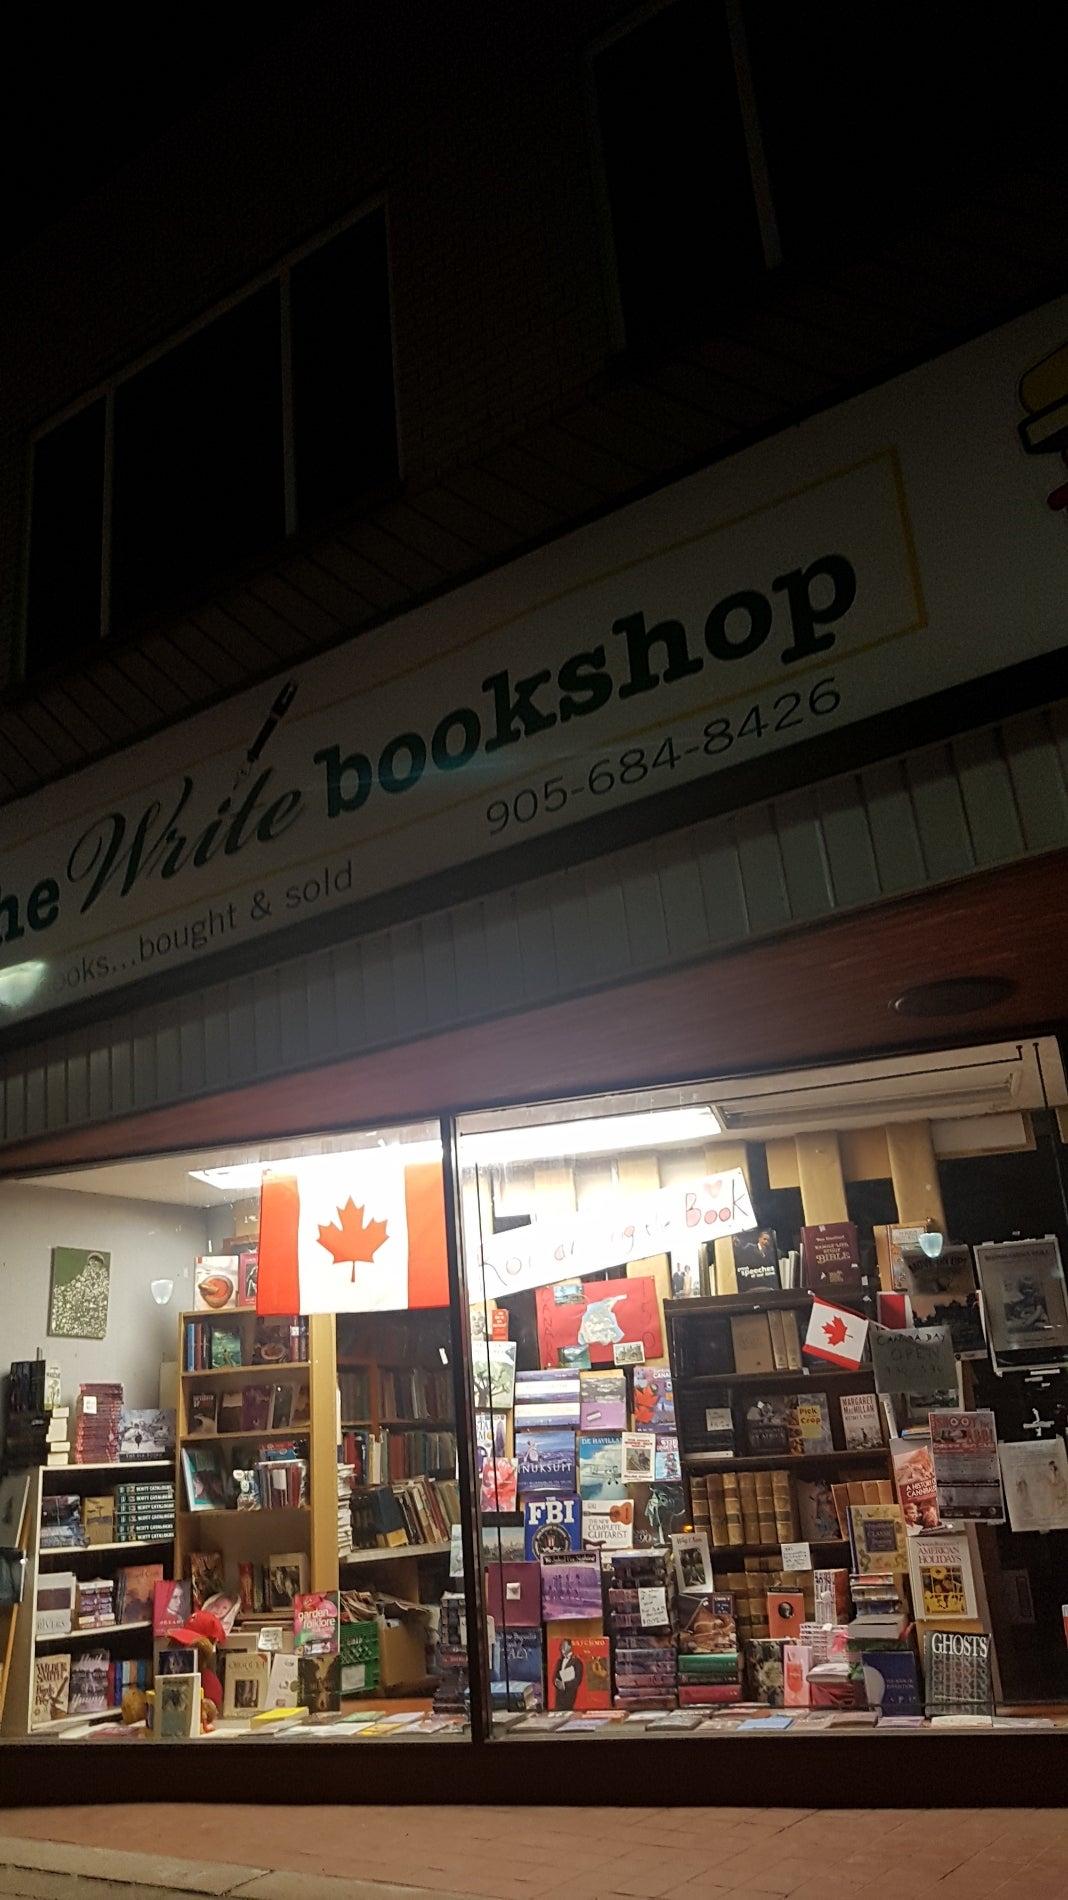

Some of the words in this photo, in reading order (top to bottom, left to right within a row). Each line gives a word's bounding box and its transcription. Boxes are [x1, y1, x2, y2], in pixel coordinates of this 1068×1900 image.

[67, 769, 307, 915] Write
[314, 553, 857, 818] bookshop
[486, 677, 840, 834] 905-684-8426
[251, 890, 272, 921] &
[286, 860, 352, 908] sold
[816, 1252, 850, 1264] BIBLE
[528, 1500, 575, 1526] FBI
[588, 1530, 628, 1539] GUITARIST
[919, 1546, 960, 1555] AMERICAN
[918, 1555, 962, 1564] HOLIDAYS
[298, 1608, 329, 1622] garden
[303, 1617, 336, 1629] folklore
[931, 1632, 988, 1658] GHOSTS
